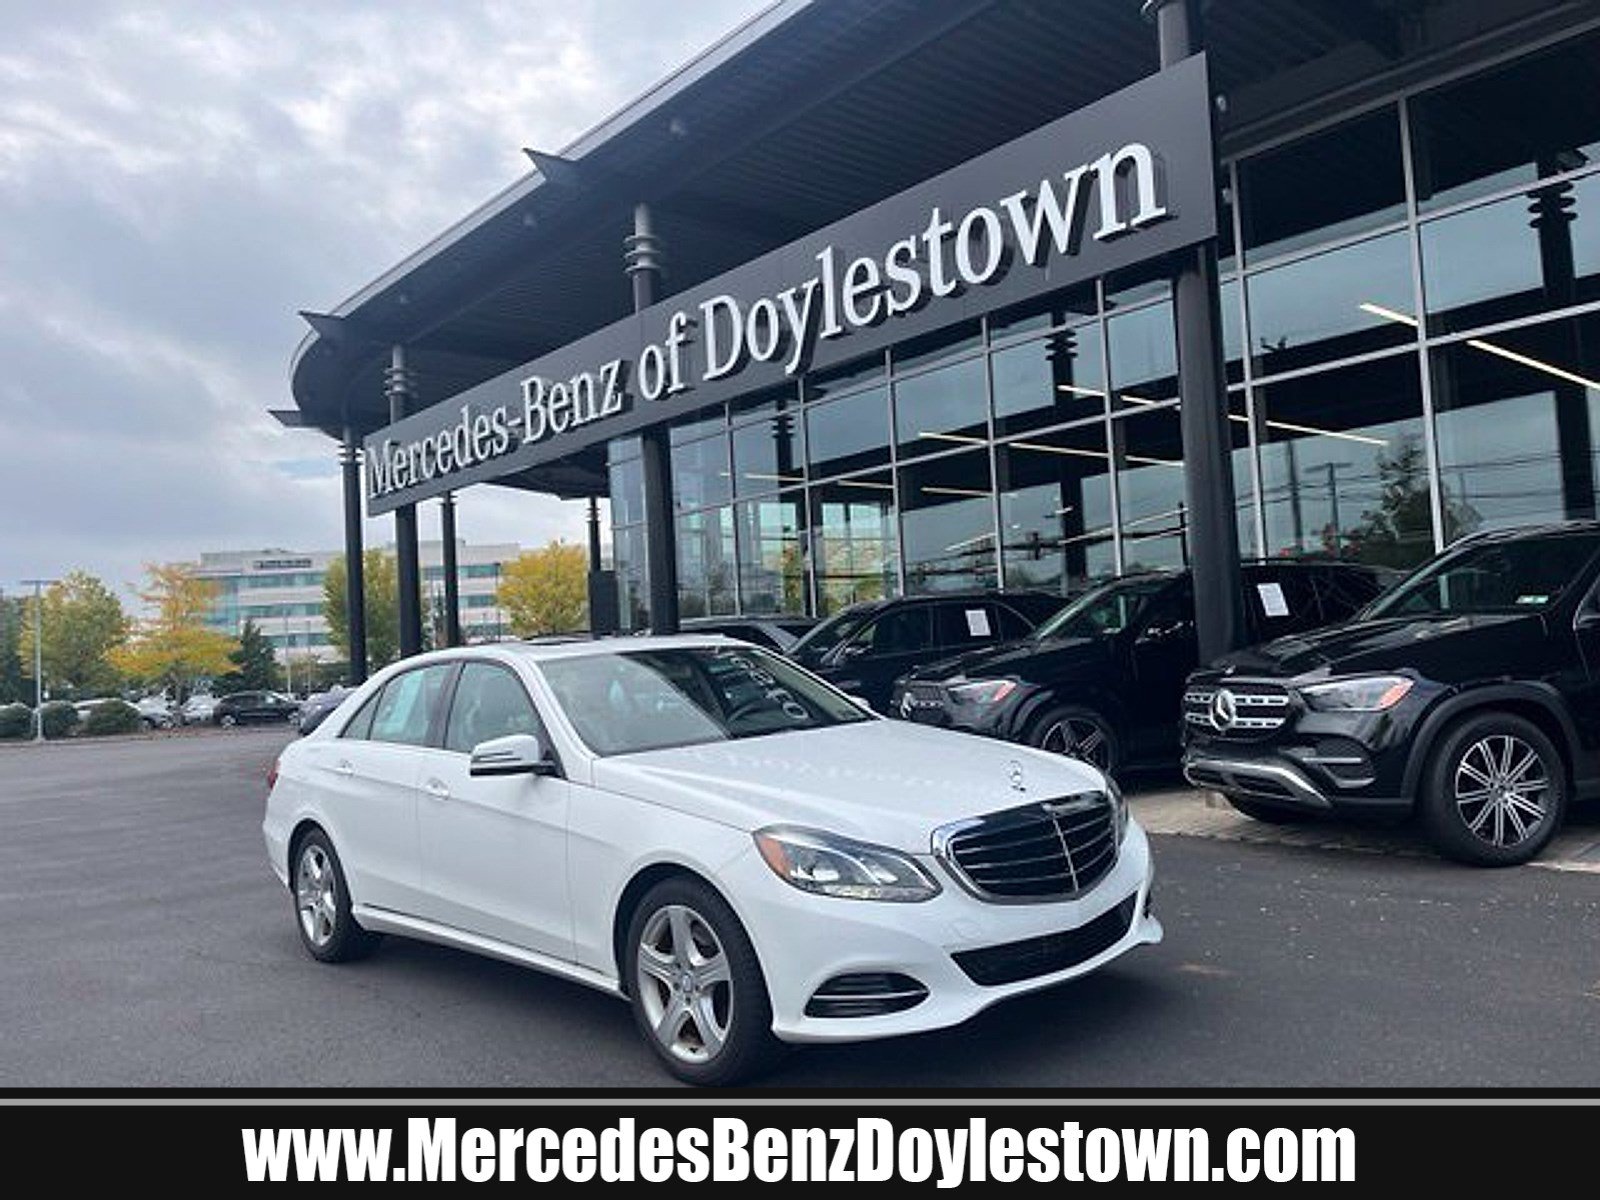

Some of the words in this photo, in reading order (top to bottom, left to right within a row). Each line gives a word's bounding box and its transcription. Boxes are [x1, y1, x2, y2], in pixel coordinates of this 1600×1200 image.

[366, 358, 623, 499] Mercedes-Benz
[638, 311, 688, 401] of
[700, 142, 1167, 381] Doylestown
